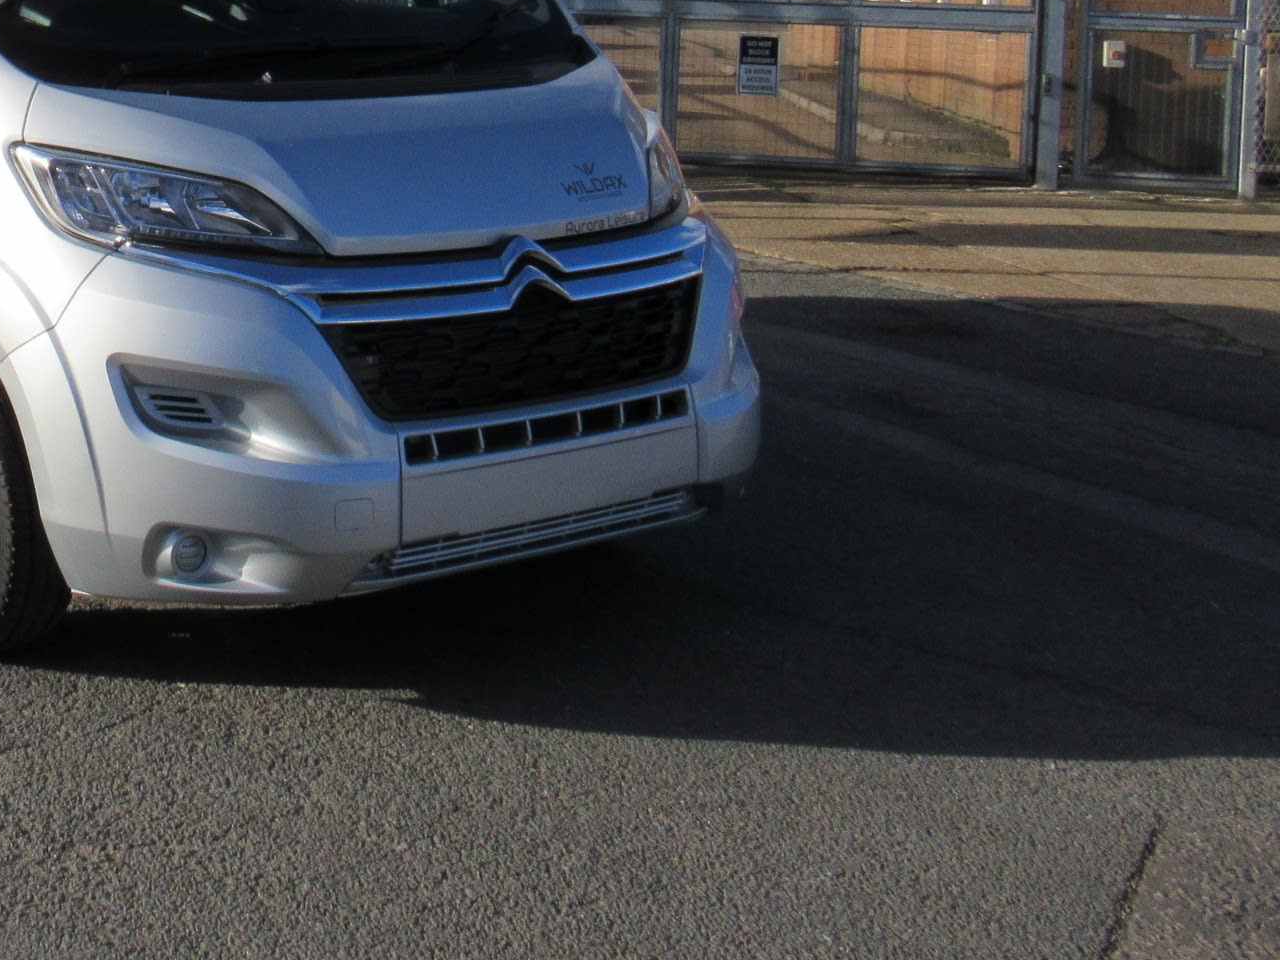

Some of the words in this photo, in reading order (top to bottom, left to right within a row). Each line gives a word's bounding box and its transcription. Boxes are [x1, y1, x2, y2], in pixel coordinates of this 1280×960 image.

[560, 175, 627, 196] WILDAX
[565, 218, 605, 234] Aurora
[607, 211, 645, 228] Leisure
